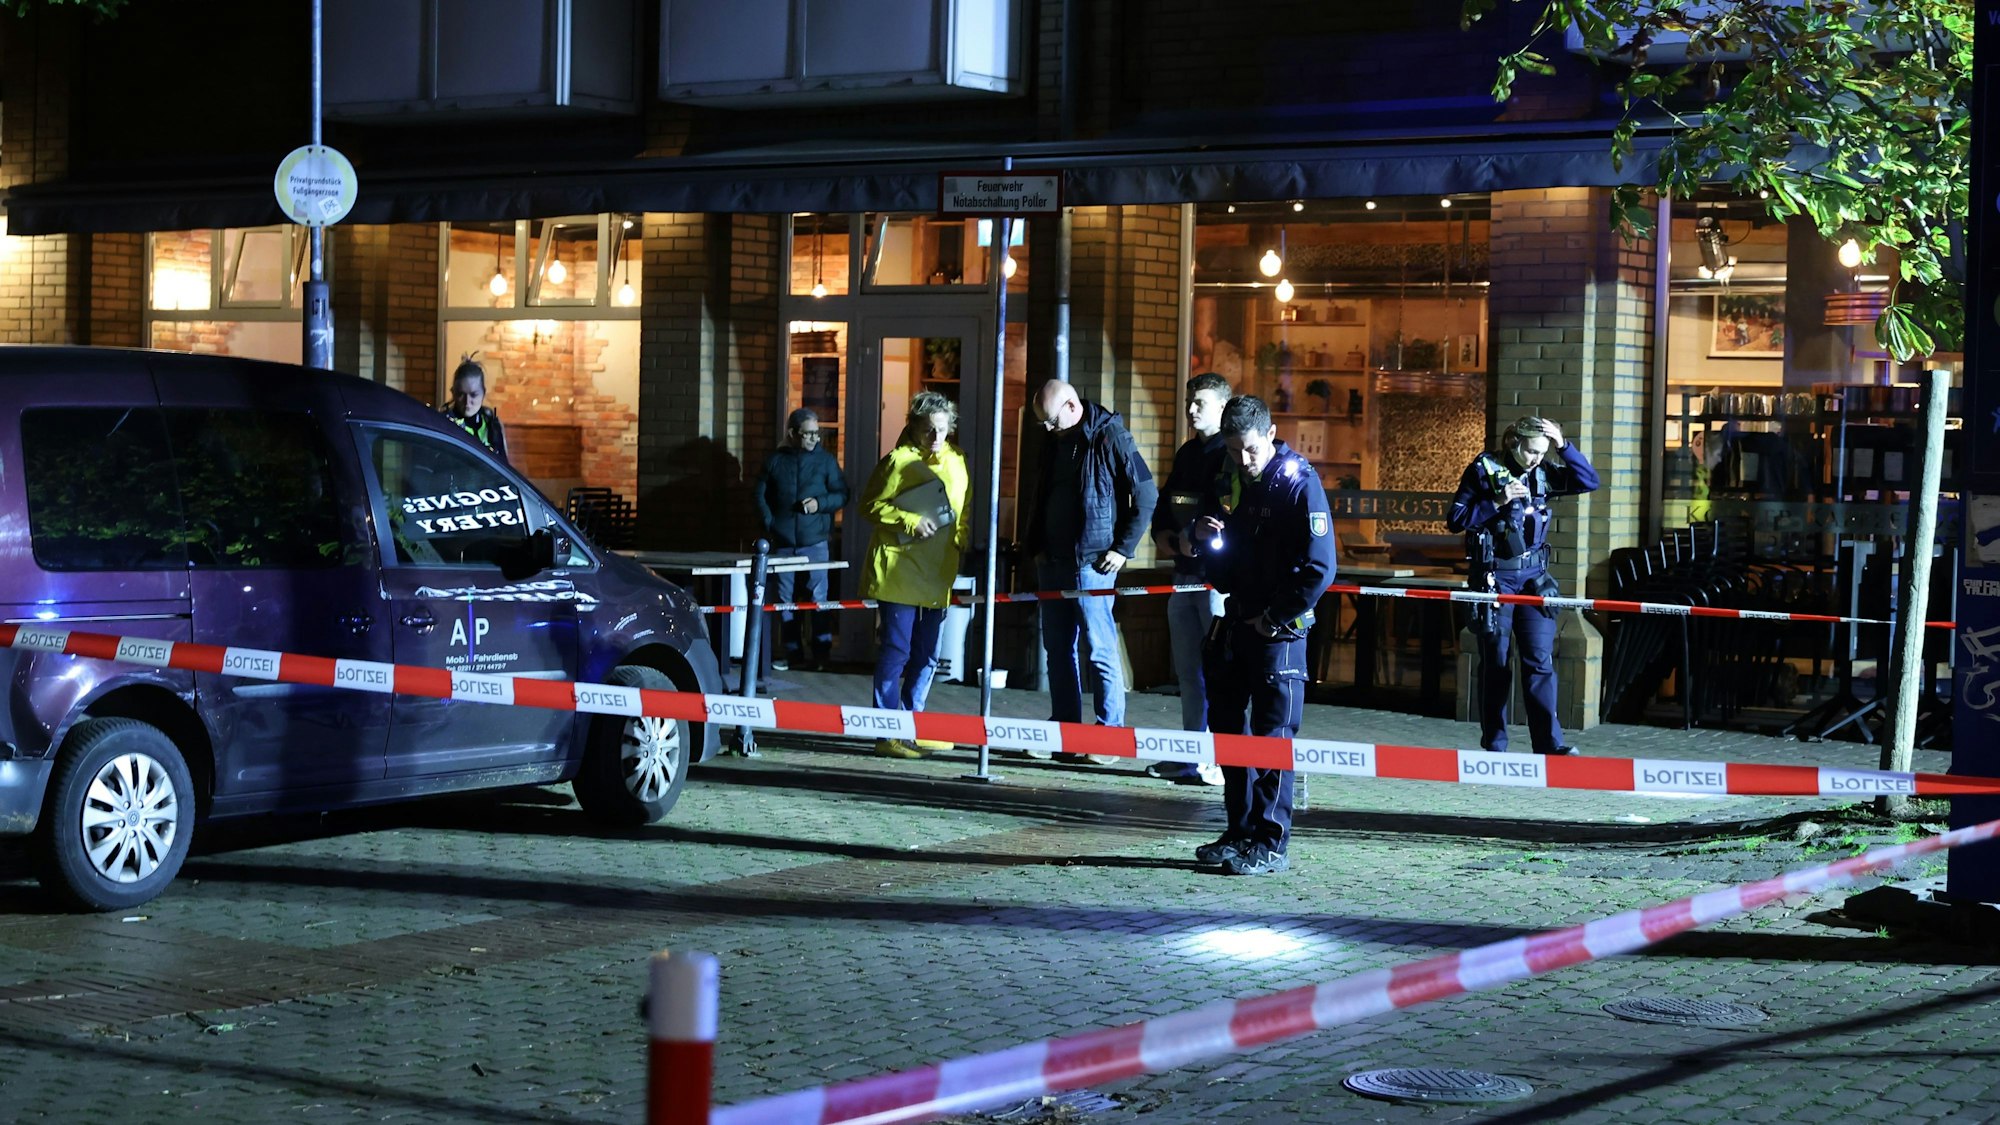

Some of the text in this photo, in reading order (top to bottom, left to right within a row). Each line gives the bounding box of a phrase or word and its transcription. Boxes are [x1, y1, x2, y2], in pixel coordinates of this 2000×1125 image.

[289, 175, 342, 186] Privatgrundstück
[977, 180, 1024, 192] Feuerwehr
[292, 187, 339, 197] Fußgängerzone
[953, 195, 1048, 210] Notabschaltung Poller
[473, 652, 518, 663] Fahrdienst
